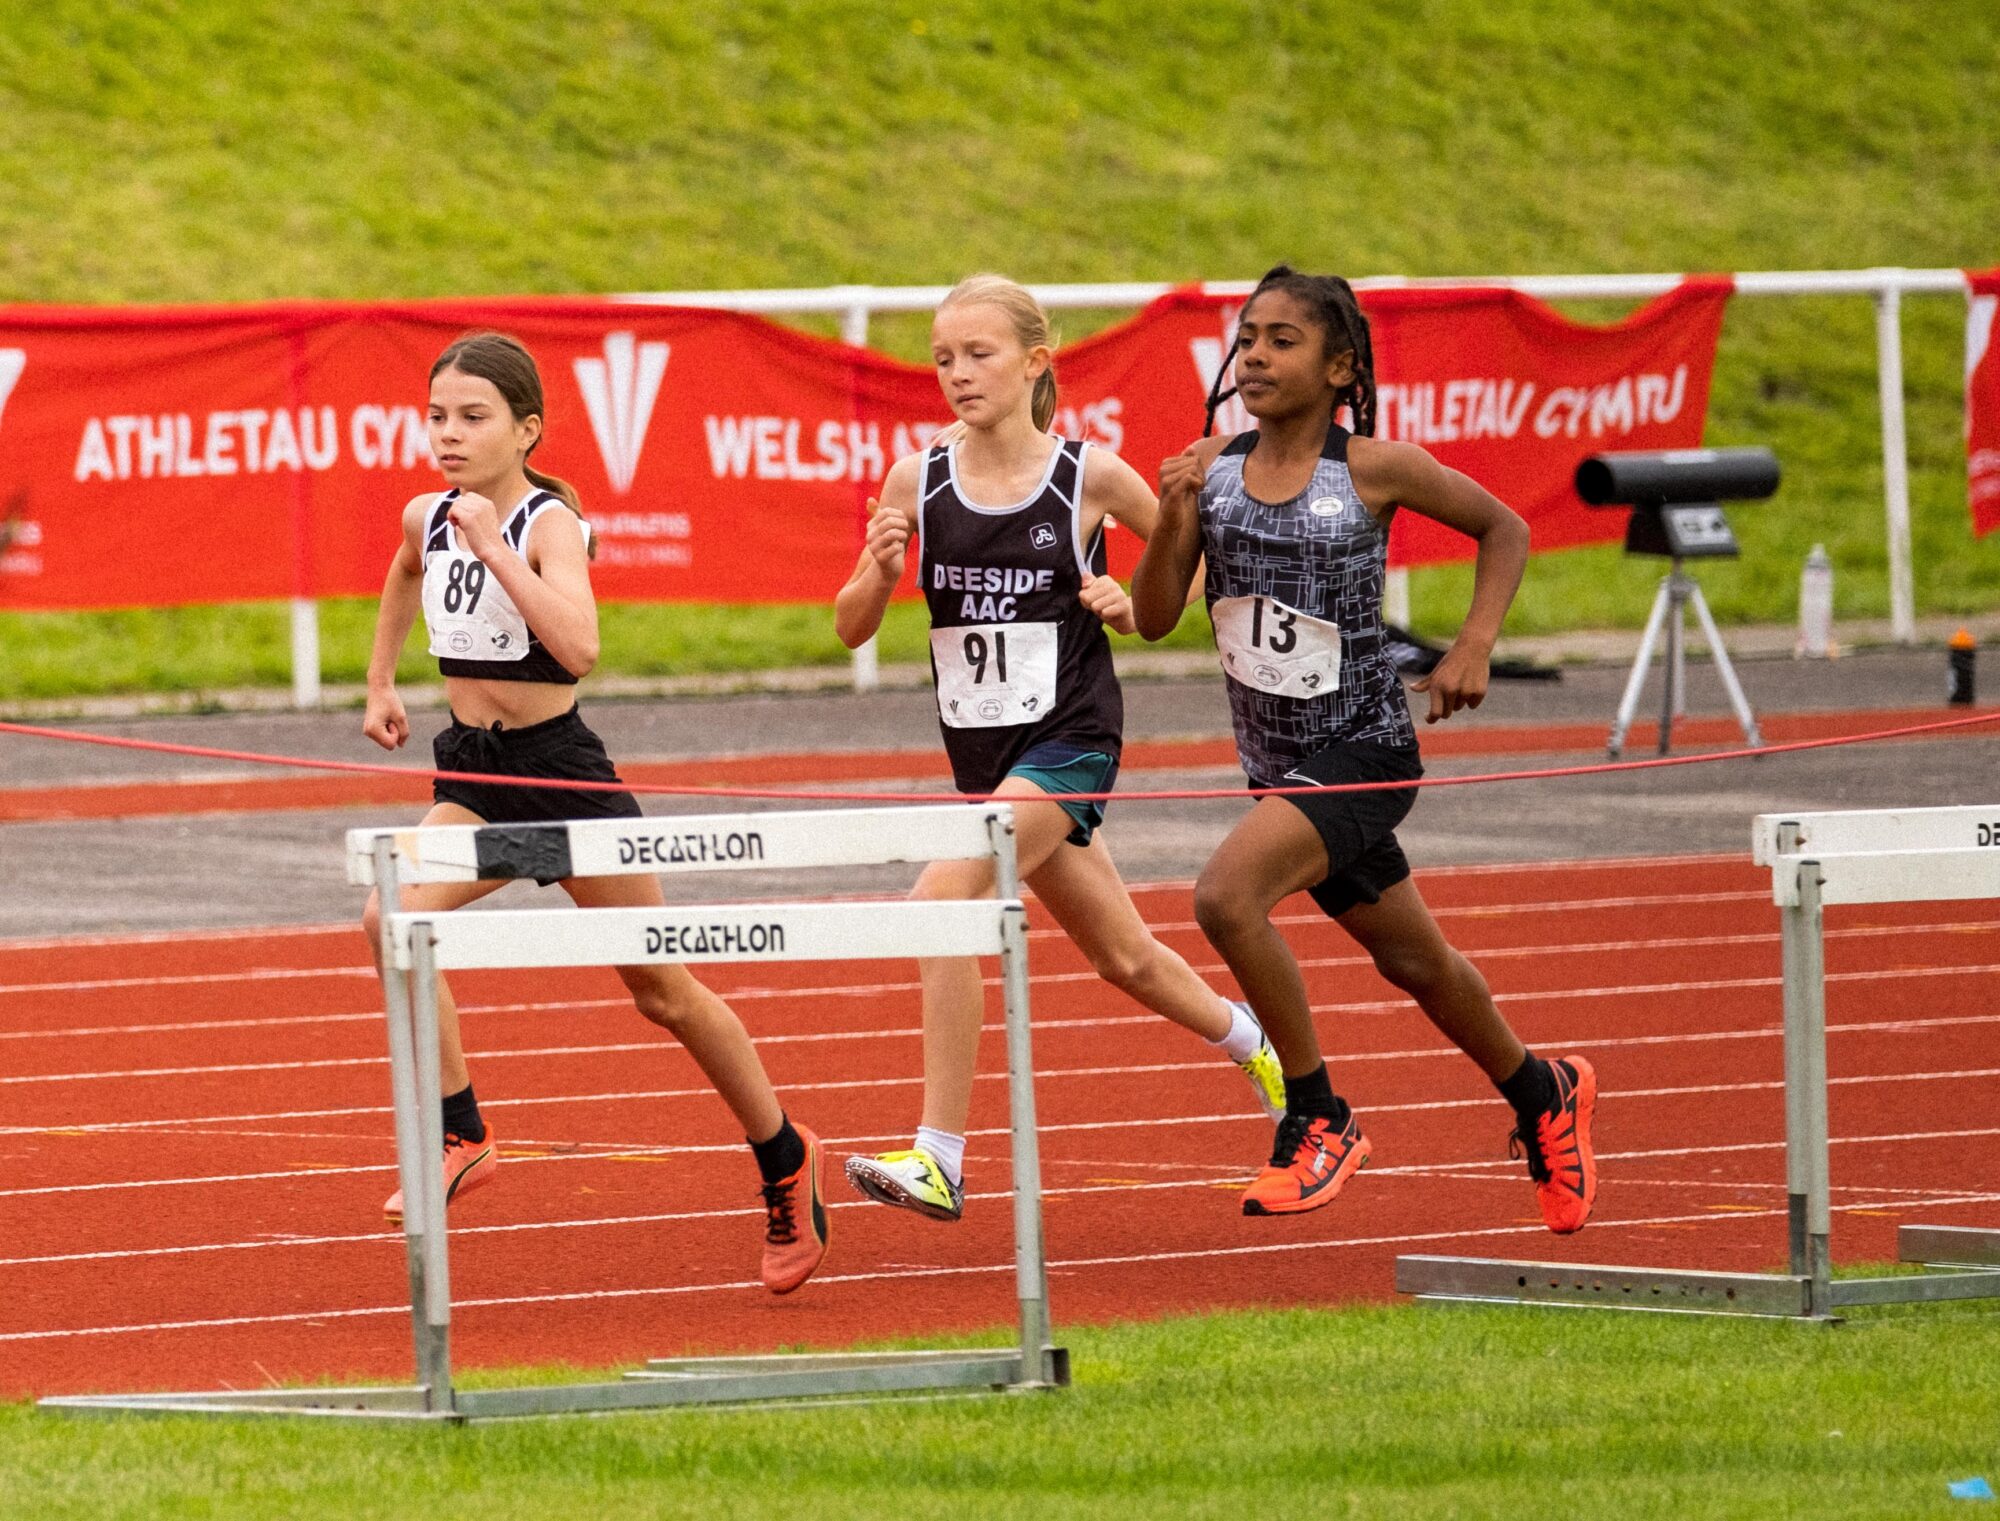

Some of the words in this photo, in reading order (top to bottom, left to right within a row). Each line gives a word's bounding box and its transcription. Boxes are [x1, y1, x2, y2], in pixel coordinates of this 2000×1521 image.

[1344, 378, 1535, 444] THLETAU
[75, 406, 339, 482] ATHLETAU
[351, 403, 440, 471] CYM
[704, 414, 885, 482] WELSH
[444, 558, 486, 615] 89
[933, 563, 1055, 594] DEESIDE
[960, 594, 1018, 622] AAC
[1252, 598, 1297, 654] 13
[963, 631, 1007, 684] 91
[618, 832, 764, 865] DECATHLON
[646, 923, 785, 955] DECATHLON
